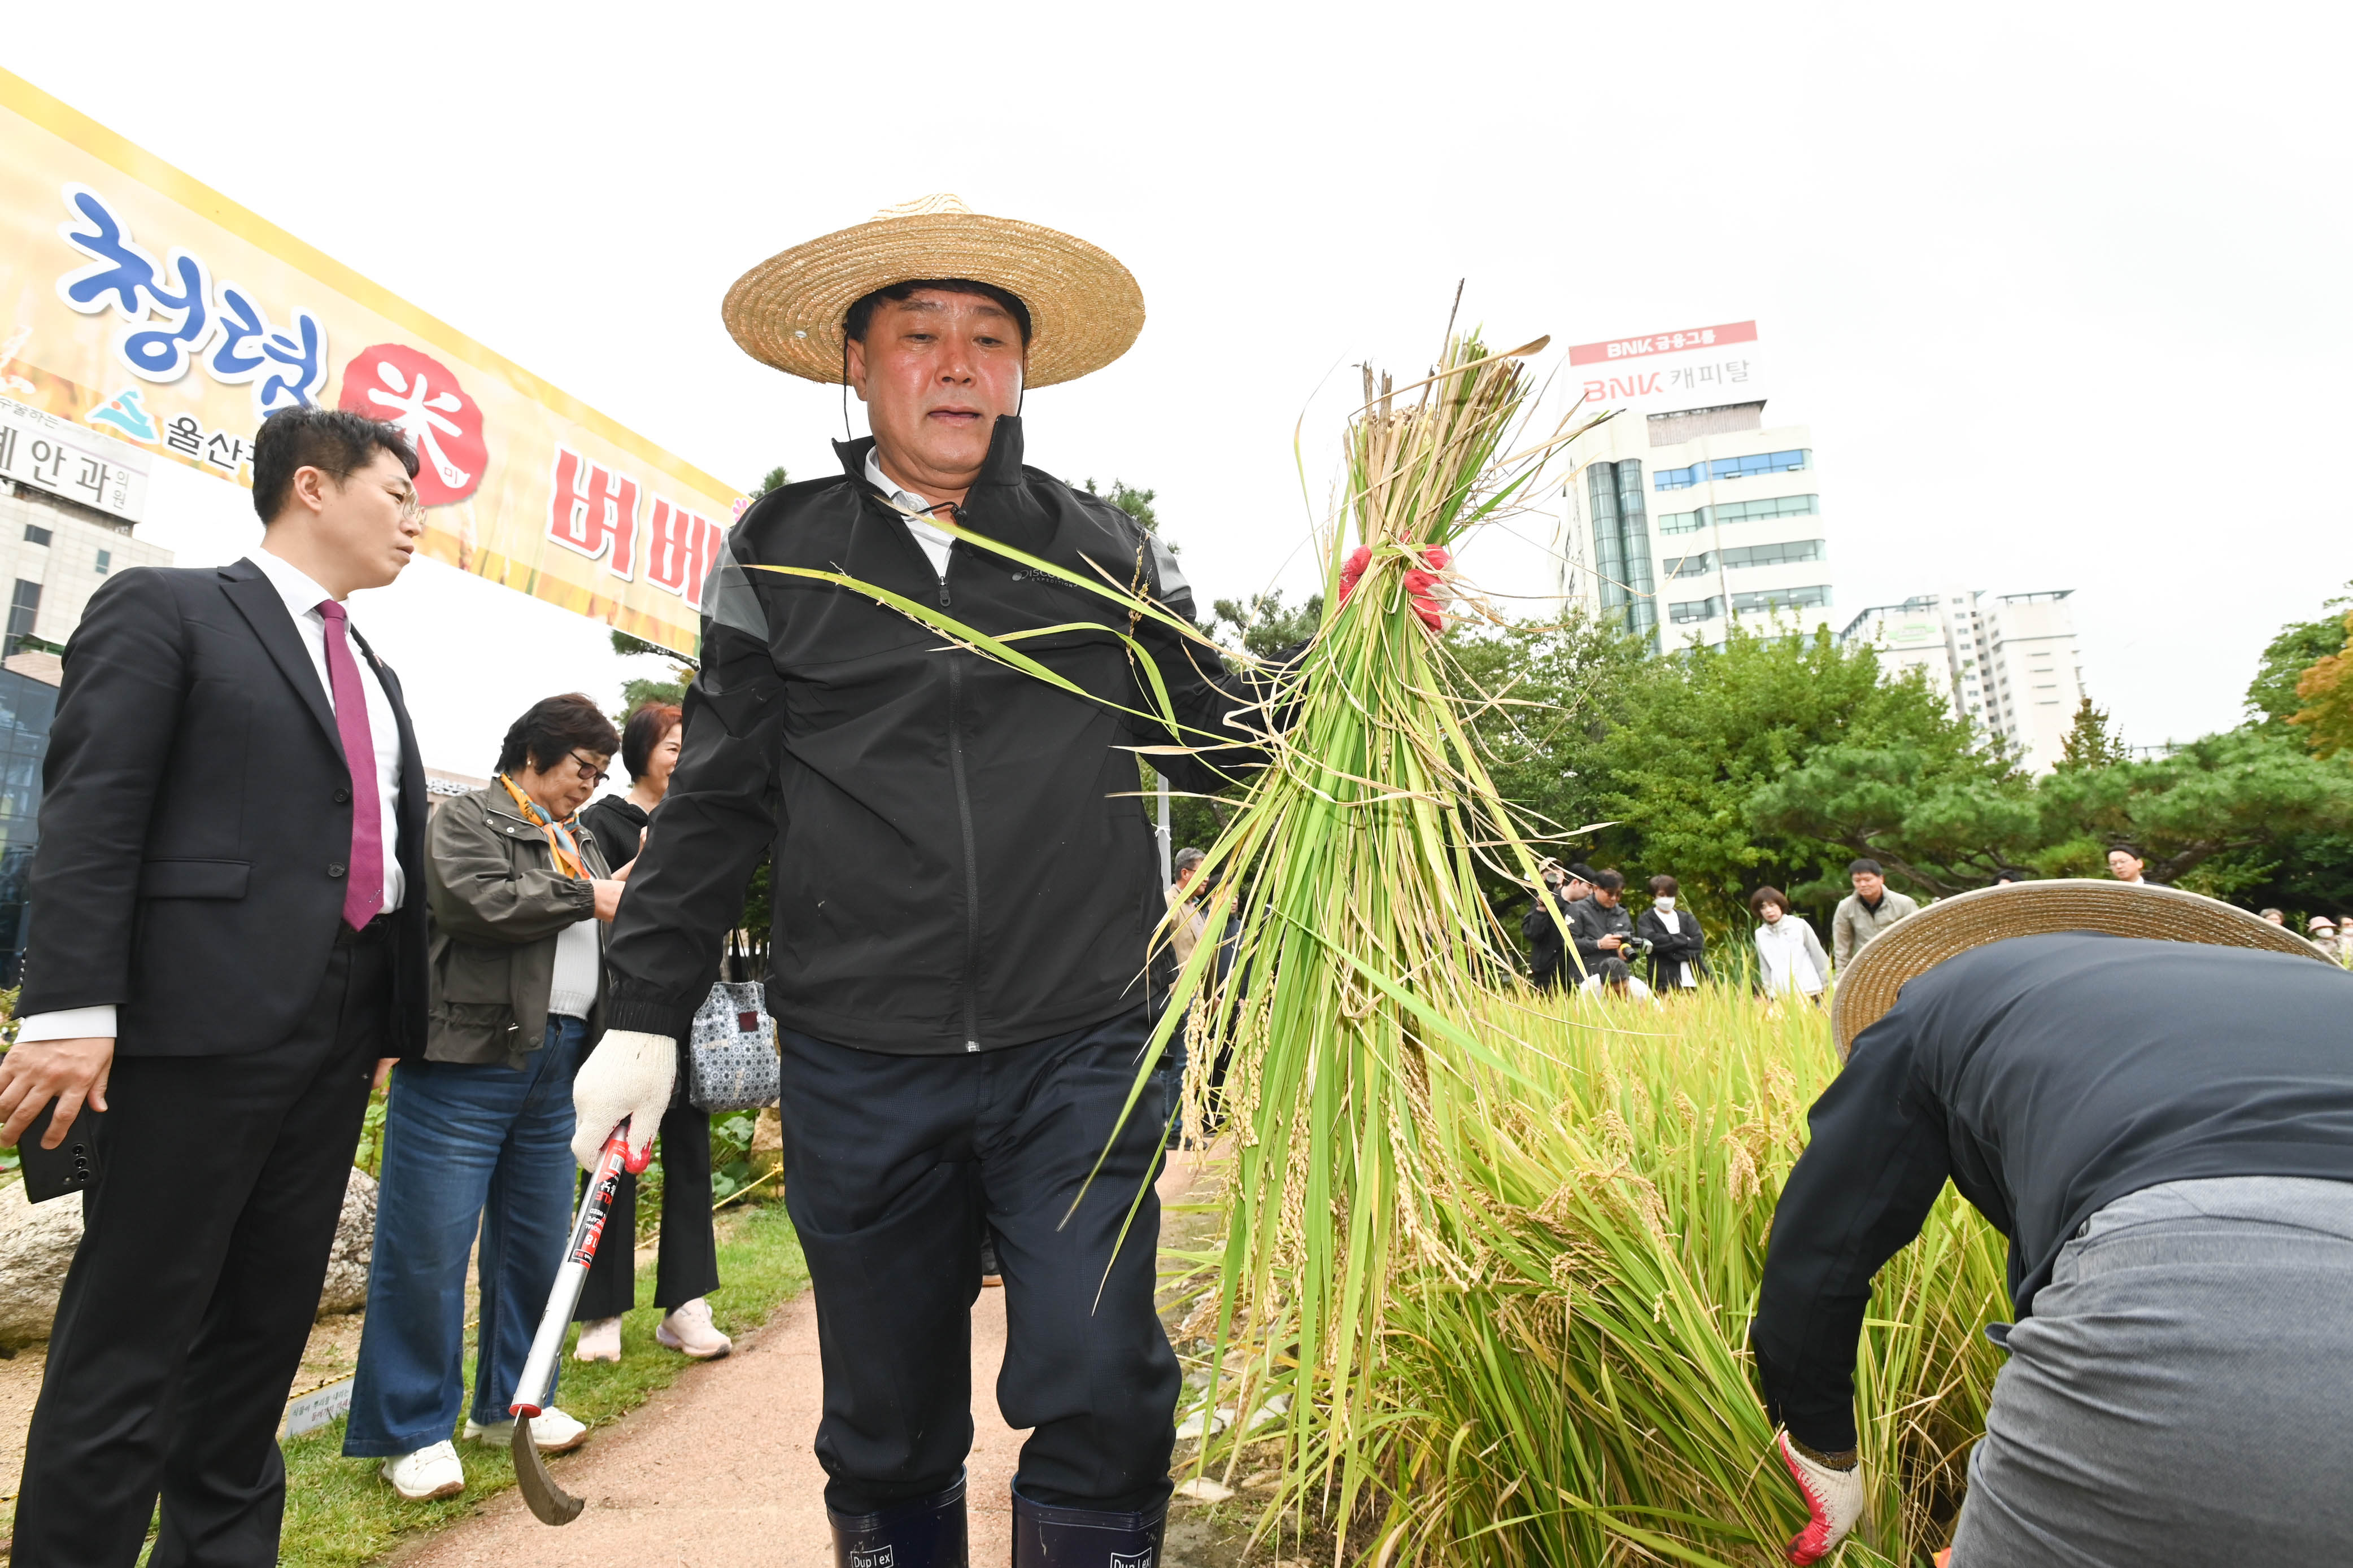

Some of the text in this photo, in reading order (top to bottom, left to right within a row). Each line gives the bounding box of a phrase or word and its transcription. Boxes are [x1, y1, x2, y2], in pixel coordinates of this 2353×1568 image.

[1607, 329, 1716, 358] BNK 금융그룹
[1583, 359, 1750, 403] BNK 캐피탈
[168, 417, 255, 470] 울산
[853, 1553, 891, 1568] Duplex
